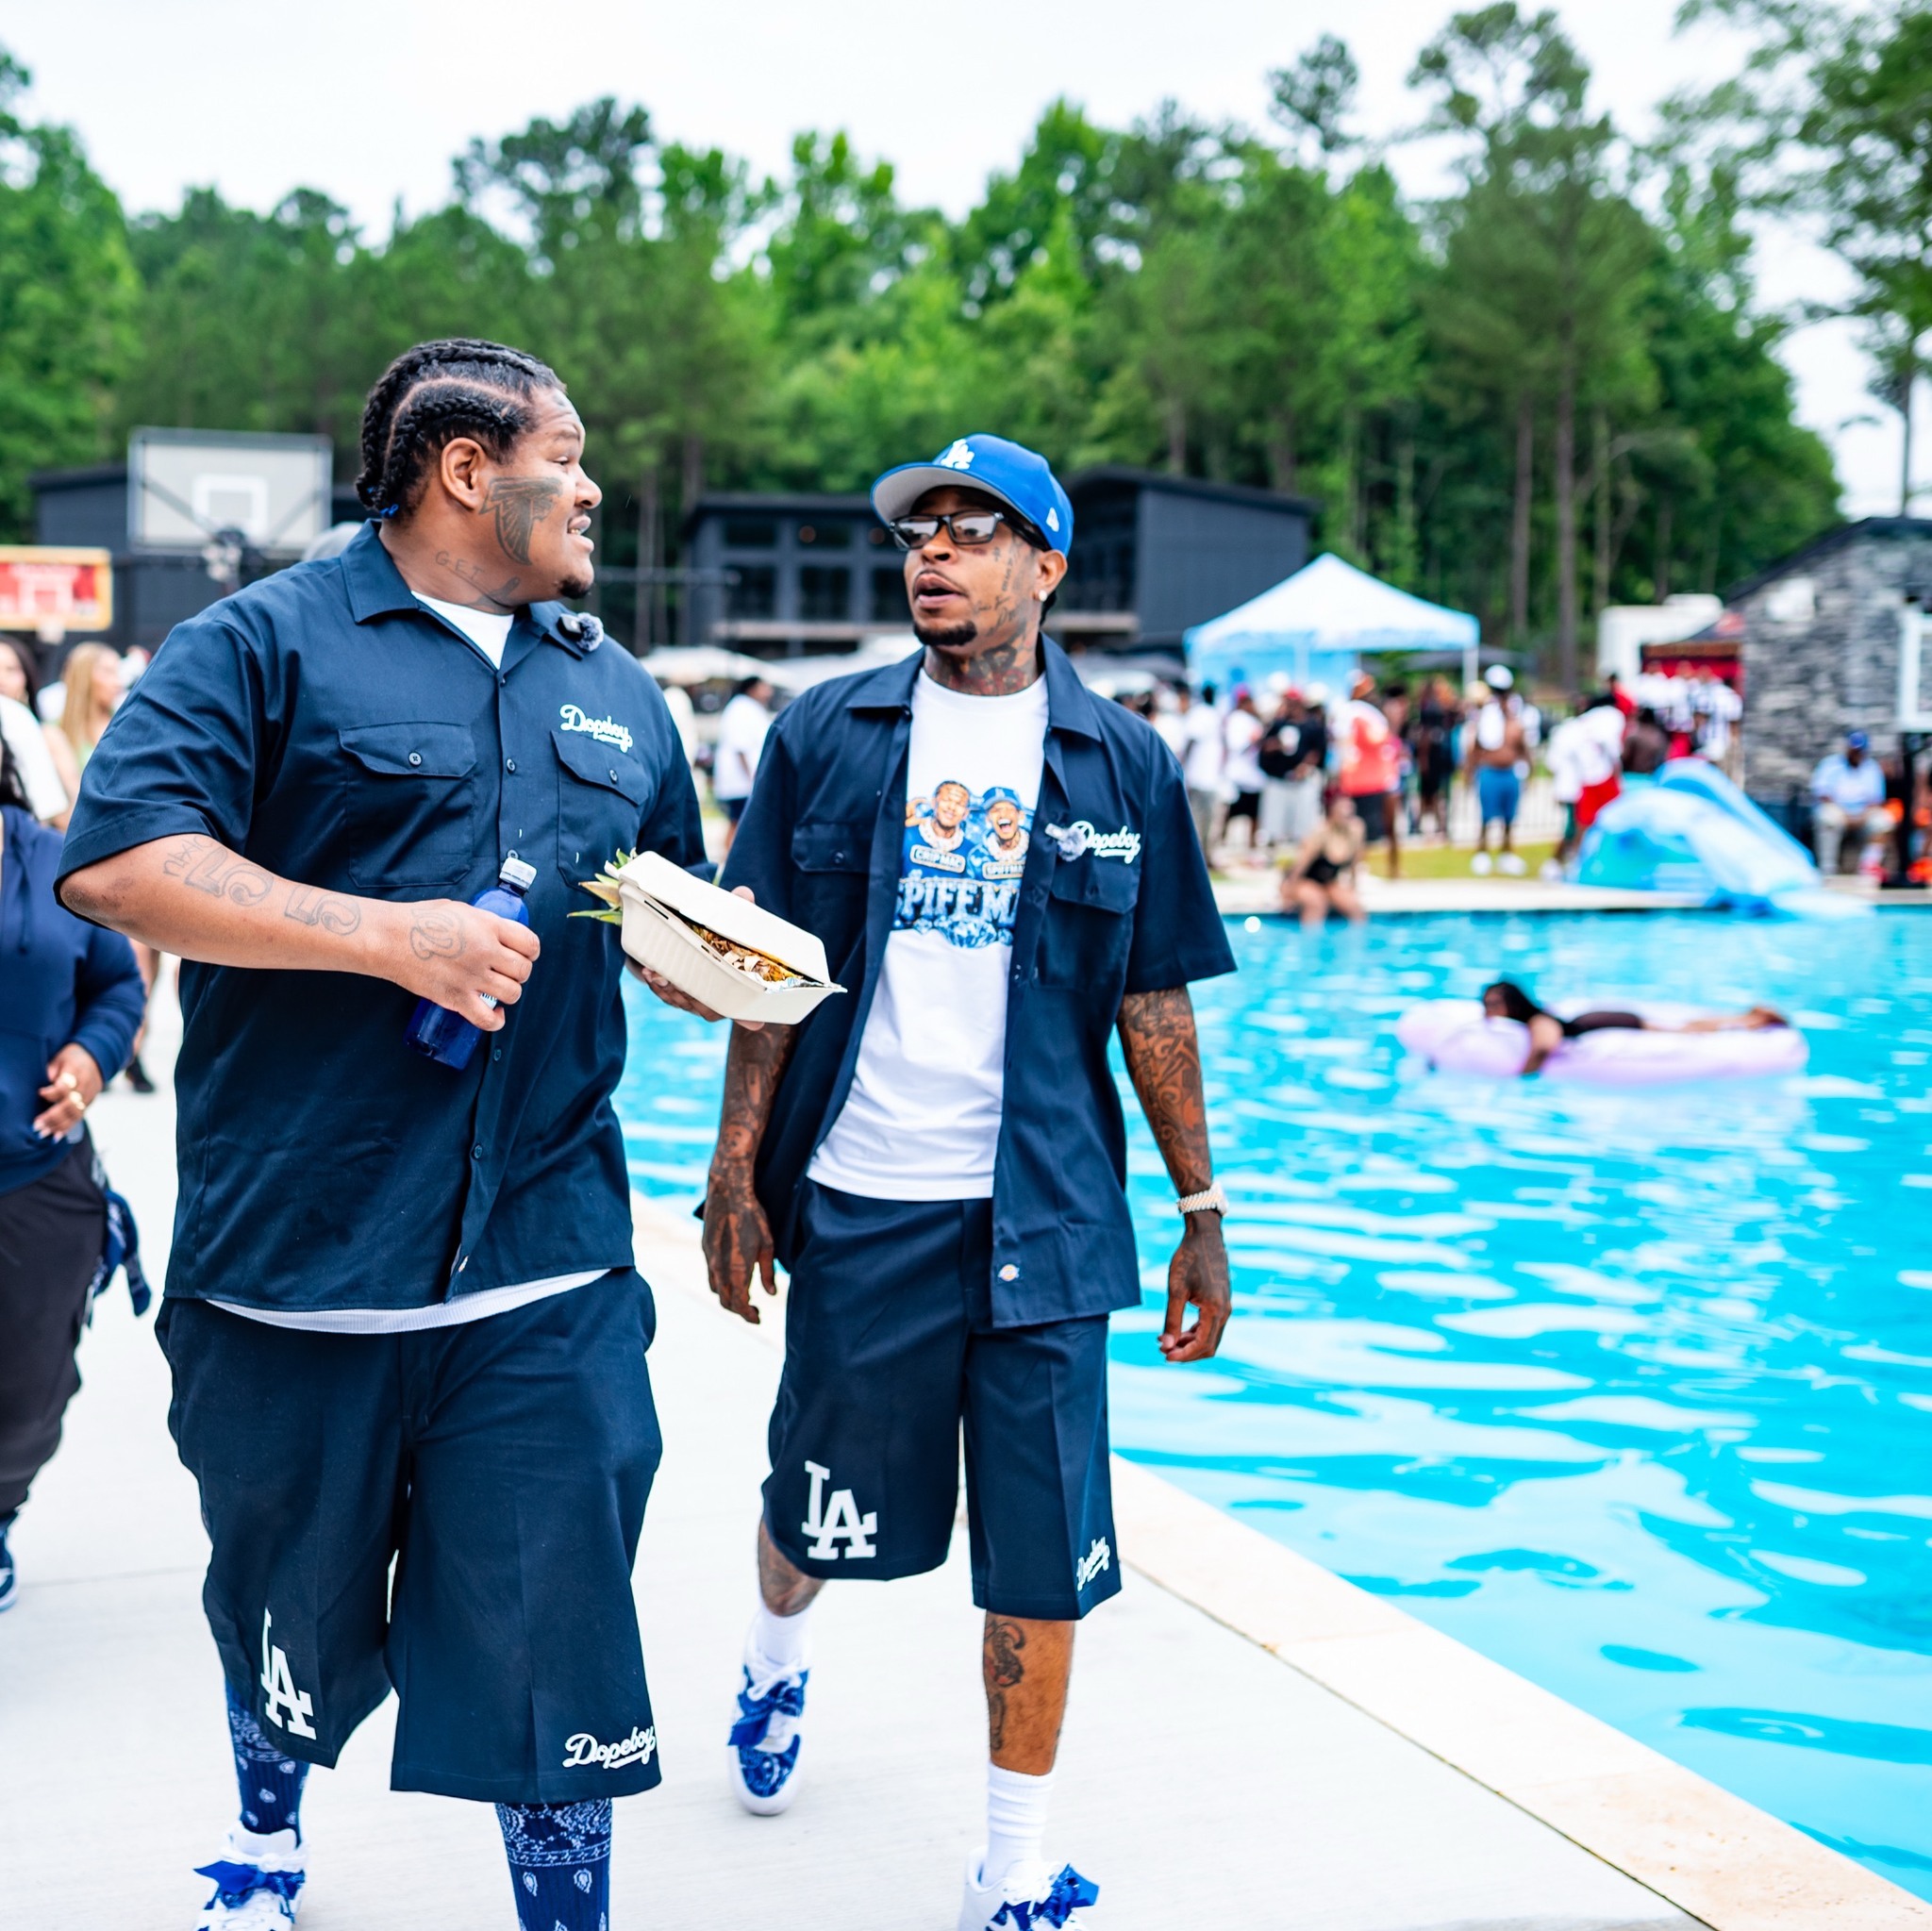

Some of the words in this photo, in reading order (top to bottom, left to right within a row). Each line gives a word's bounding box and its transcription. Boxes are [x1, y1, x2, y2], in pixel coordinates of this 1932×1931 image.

[435, 550, 486, 581] GET
[559, 704, 633, 754] Dopeboy
[801, 1459, 878, 1561] LA
[259, 1606, 317, 1740] LA
[561, 1725, 658, 1770] Dopeboy
